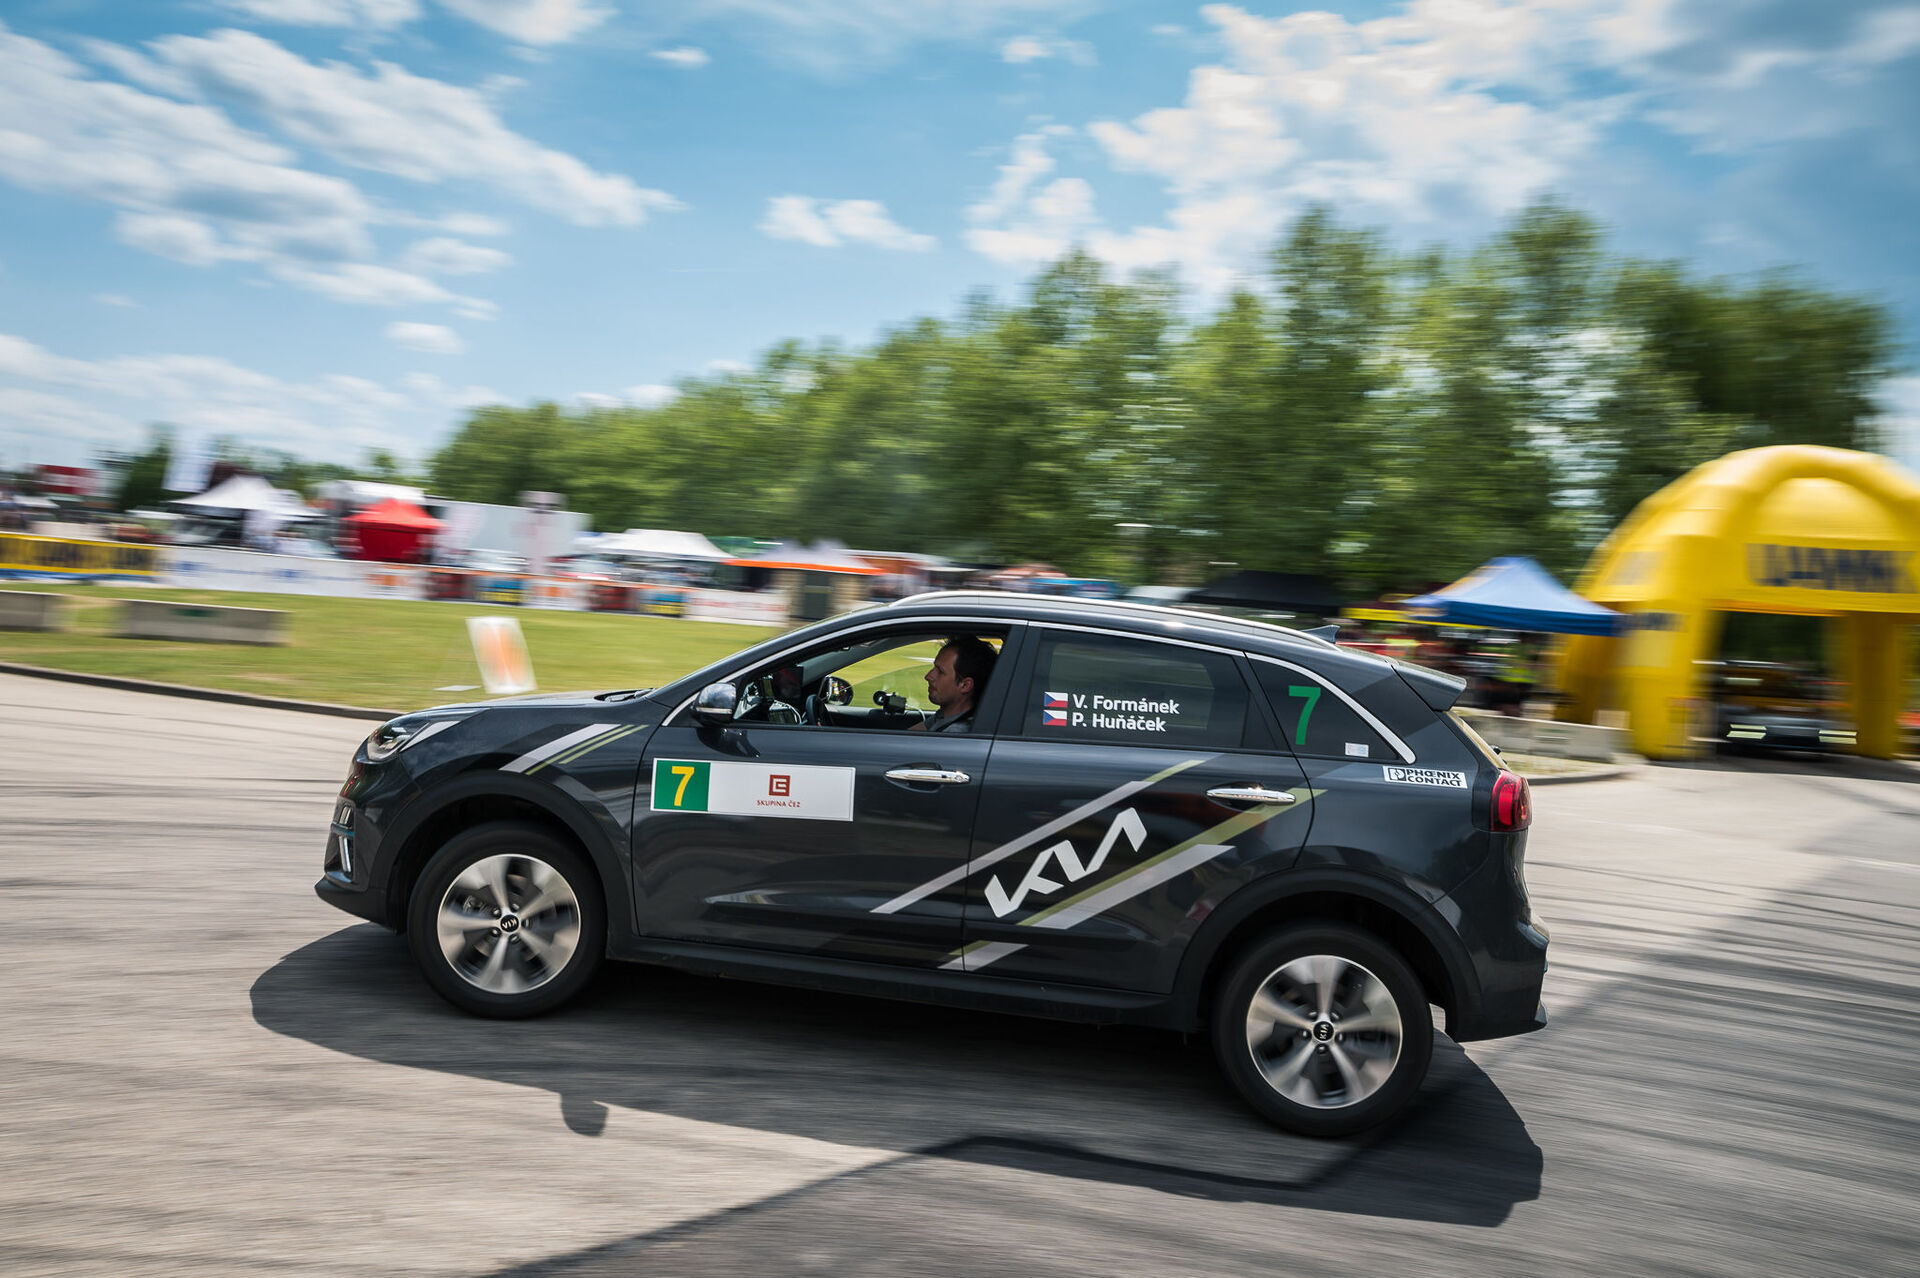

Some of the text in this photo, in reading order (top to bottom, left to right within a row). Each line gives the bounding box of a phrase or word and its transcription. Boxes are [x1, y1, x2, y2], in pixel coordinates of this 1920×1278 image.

[1072, 693, 1180, 715] V. Formánek
[1288, 685, 1321, 745] 7
[1071, 712, 1166, 732] P. Huňáček
[671, 765, 695, 807] 7
[1407, 775, 1462, 787] CONTACT
